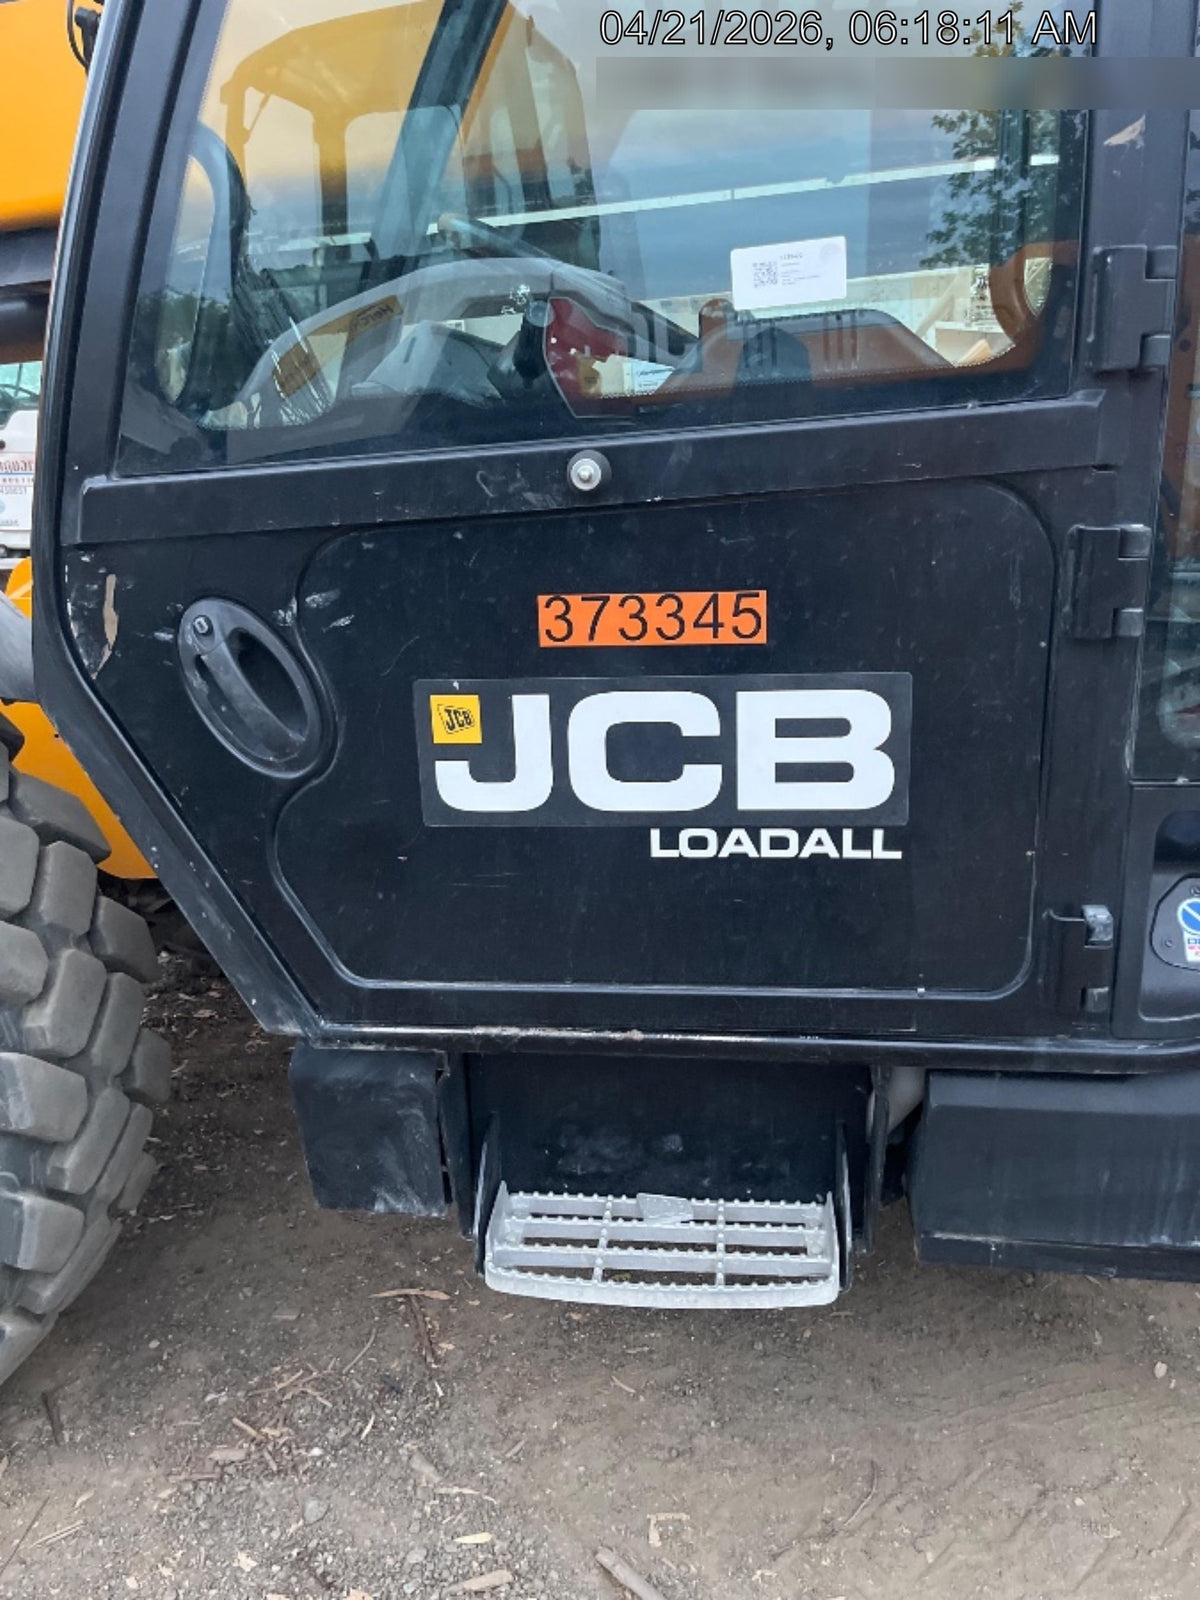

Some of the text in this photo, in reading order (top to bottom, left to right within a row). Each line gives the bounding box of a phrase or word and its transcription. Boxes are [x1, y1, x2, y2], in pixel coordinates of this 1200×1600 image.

[545, 593, 762, 642] 373345
[444, 708, 472, 731] JCB
[435, 690, 894, 812] JCB
[651, 828, 903, 860] LOADALL
